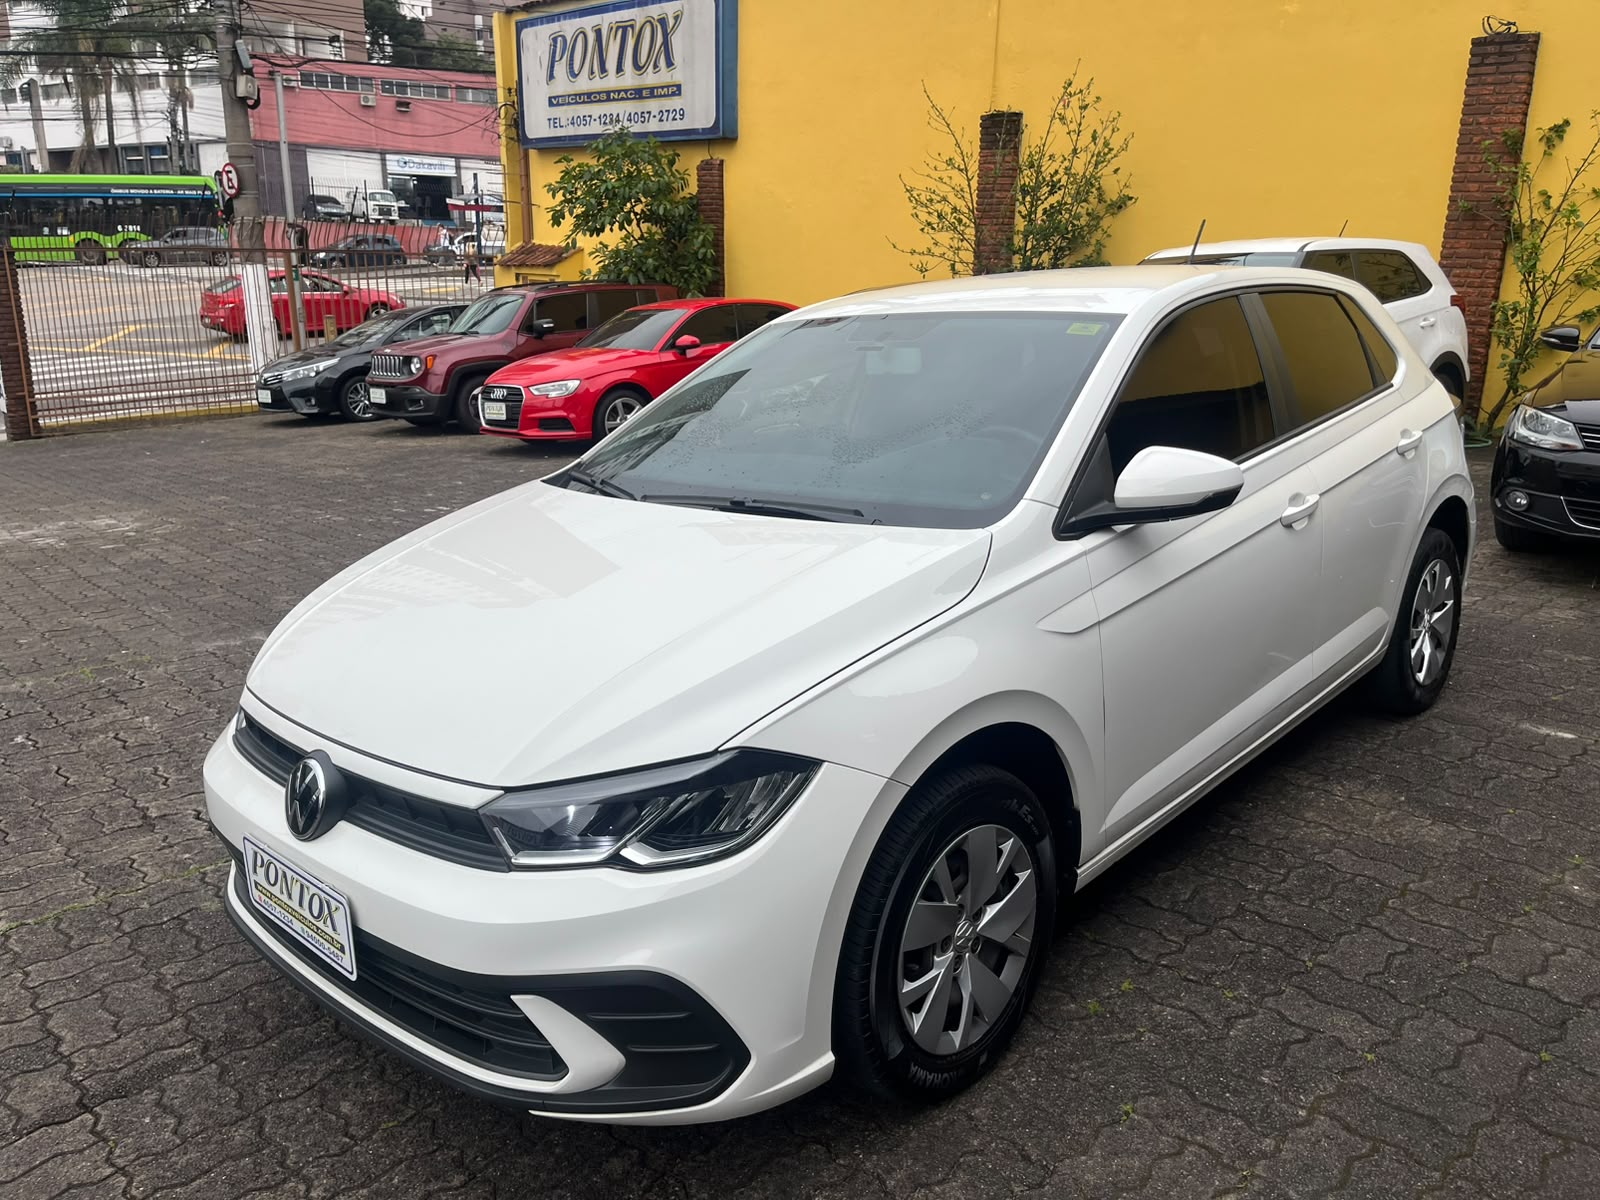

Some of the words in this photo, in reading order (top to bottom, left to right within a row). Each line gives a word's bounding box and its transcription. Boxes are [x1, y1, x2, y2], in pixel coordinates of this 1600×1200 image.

[546, 9, 684, 85] PONTOX
[610, 90, 639, 100] NAC.
[642, 88, 651, 97] E
[653, 86, 680, 96] IMP.
[251, 847, 341, 936] PONTOX
